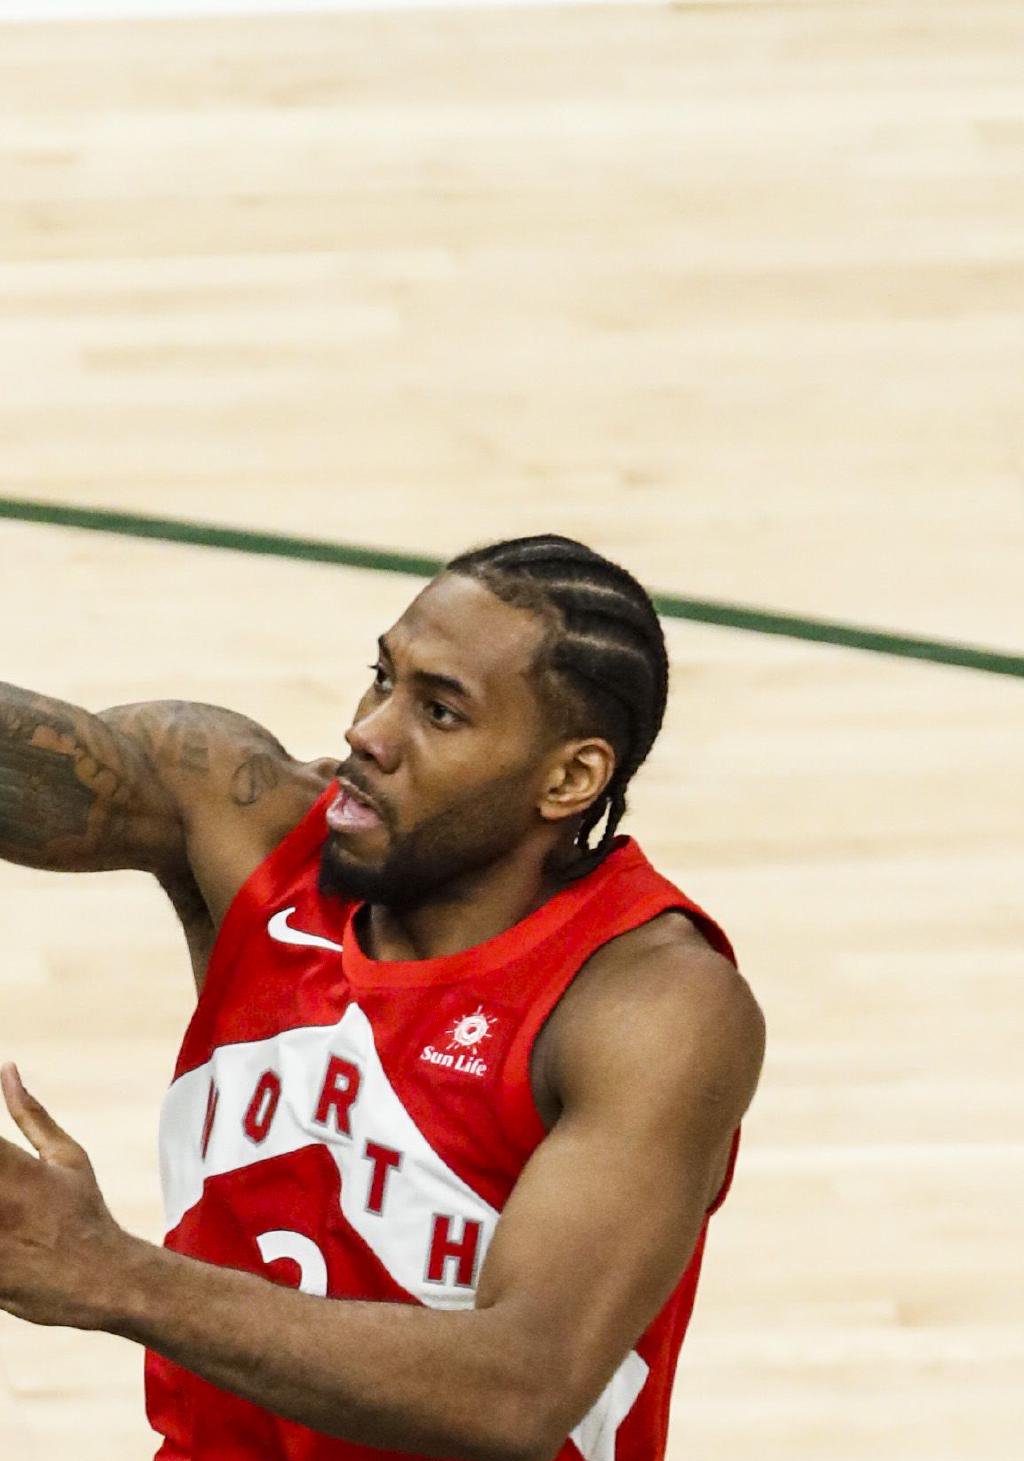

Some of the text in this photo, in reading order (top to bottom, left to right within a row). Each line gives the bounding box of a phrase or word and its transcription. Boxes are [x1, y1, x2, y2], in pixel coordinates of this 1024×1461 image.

[420, 1045, 487, 1077] Sun Life
[200, 1050, 483, 1288] ORTH
